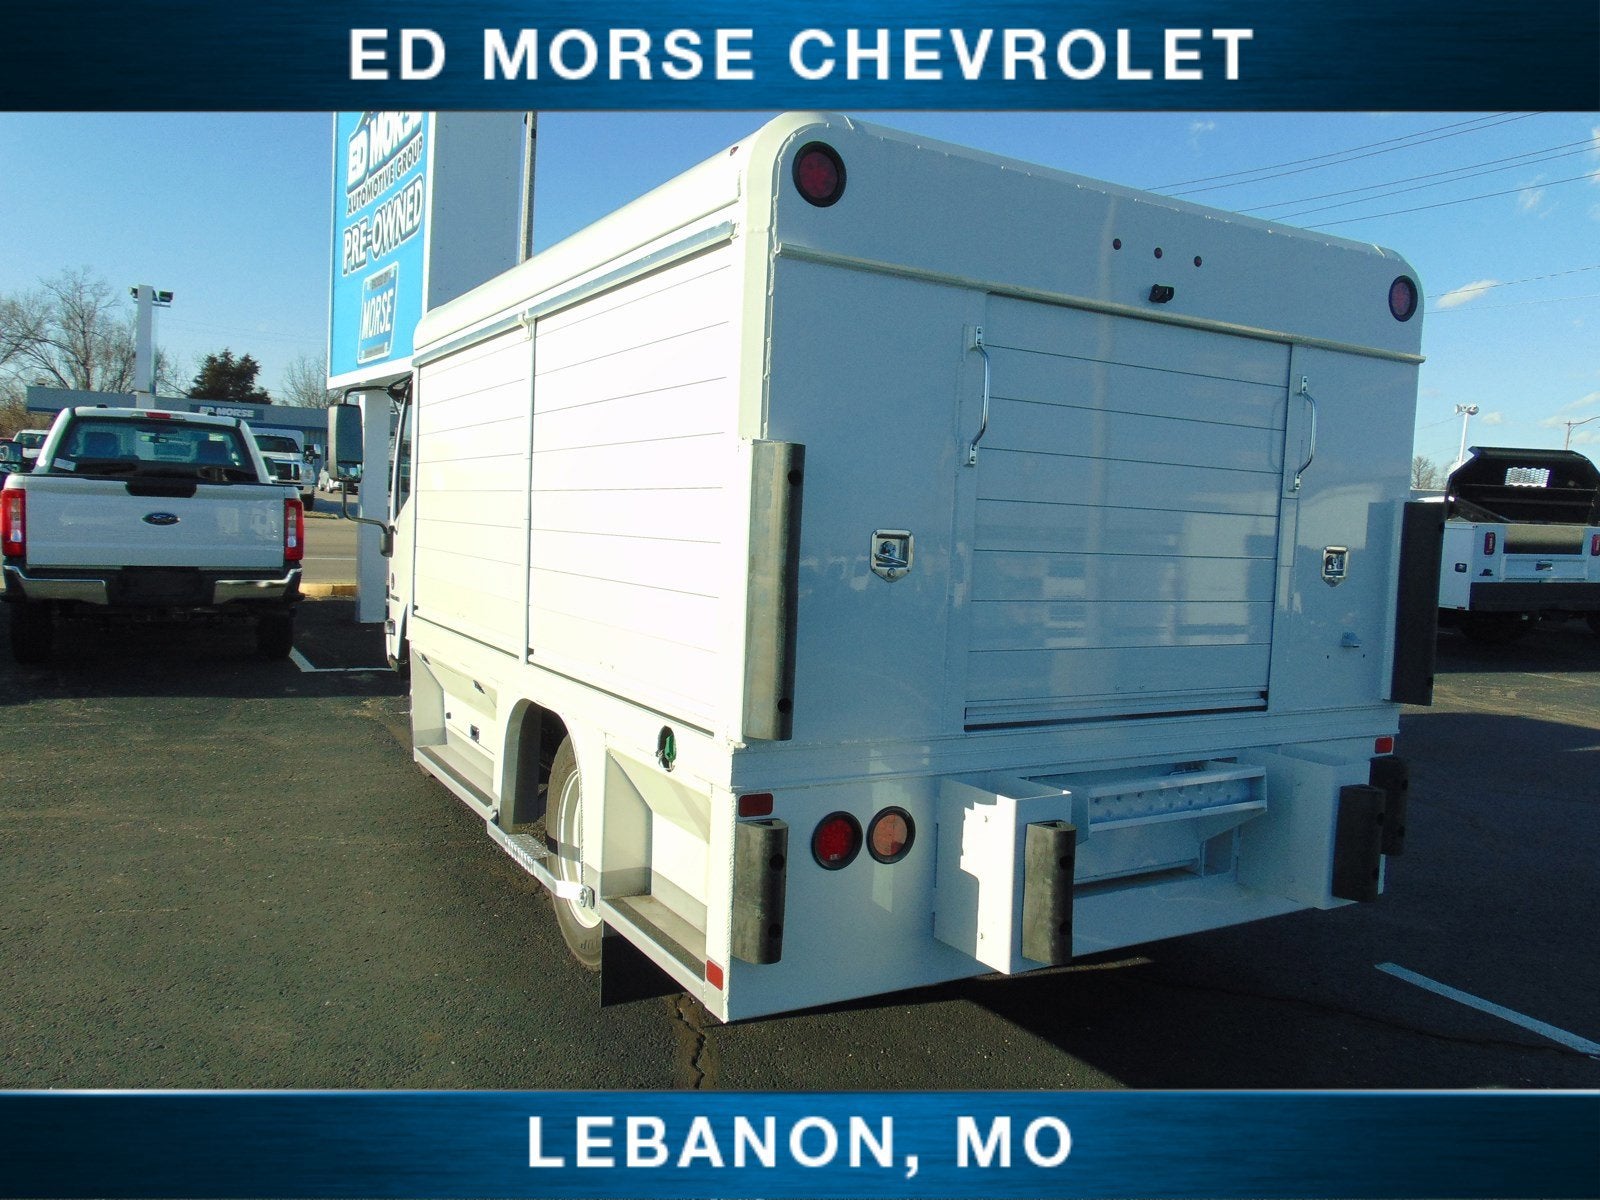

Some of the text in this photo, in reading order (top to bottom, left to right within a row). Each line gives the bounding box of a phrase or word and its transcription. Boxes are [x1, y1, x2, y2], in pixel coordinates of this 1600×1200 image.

[347, 130, 369, 189] ED
[347, 135, 423, 213] AUTOMOTIVE GROUP
[343, 176, 423, 275] PRE-OWNED
[362, 288, 394, 340] MORSE
[216, 407, 255, 418] MORSE
